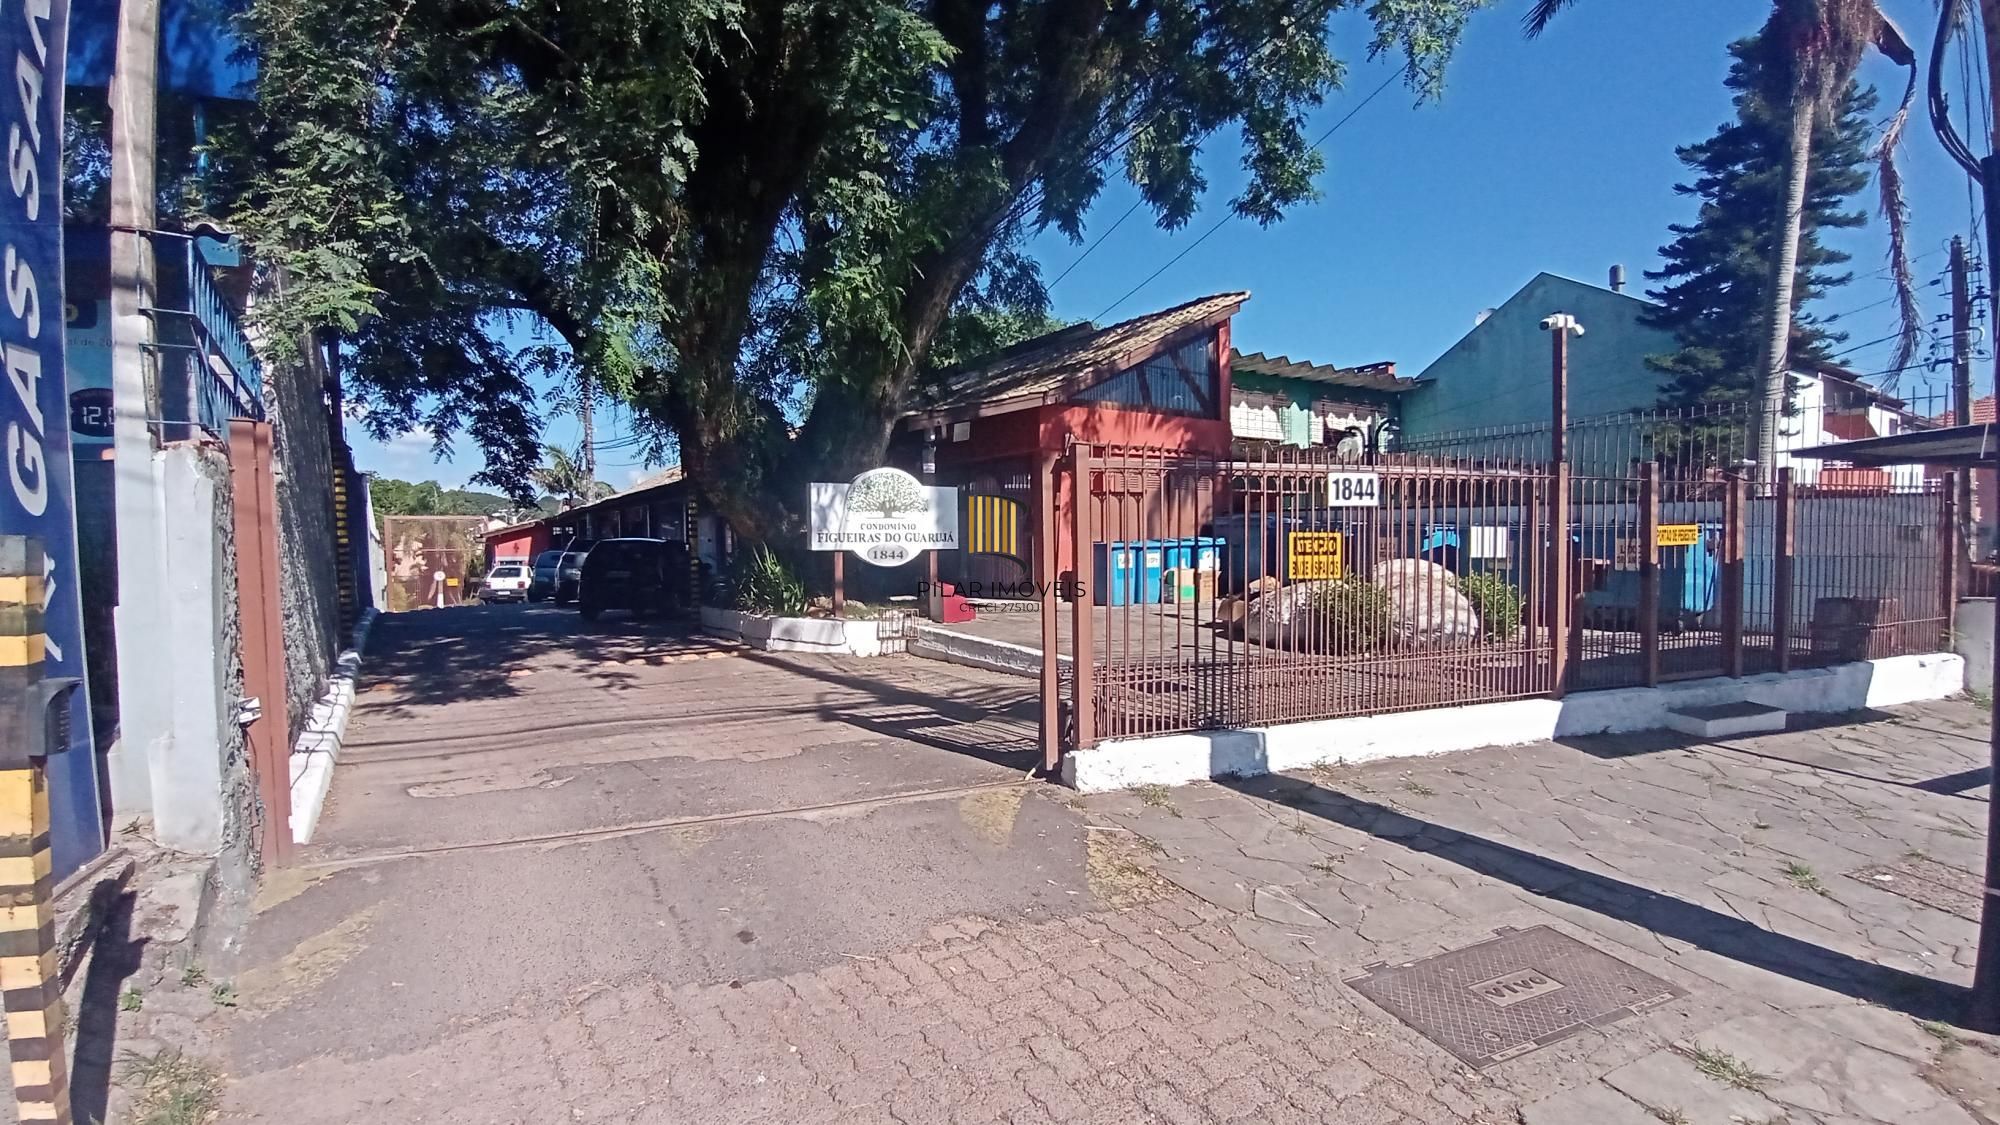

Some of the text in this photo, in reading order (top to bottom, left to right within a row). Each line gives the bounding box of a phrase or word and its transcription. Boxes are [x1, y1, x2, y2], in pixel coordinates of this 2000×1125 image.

[0, 243, 48, 517] GÁS
[1332, 478, 1375, 500] 1844
[817, 531, 954, 543] FIGUEIRAS DO GUARUJÁ
[873, 550, 905, 560] 1844
[1485, 977, 1548, 997] vivo
